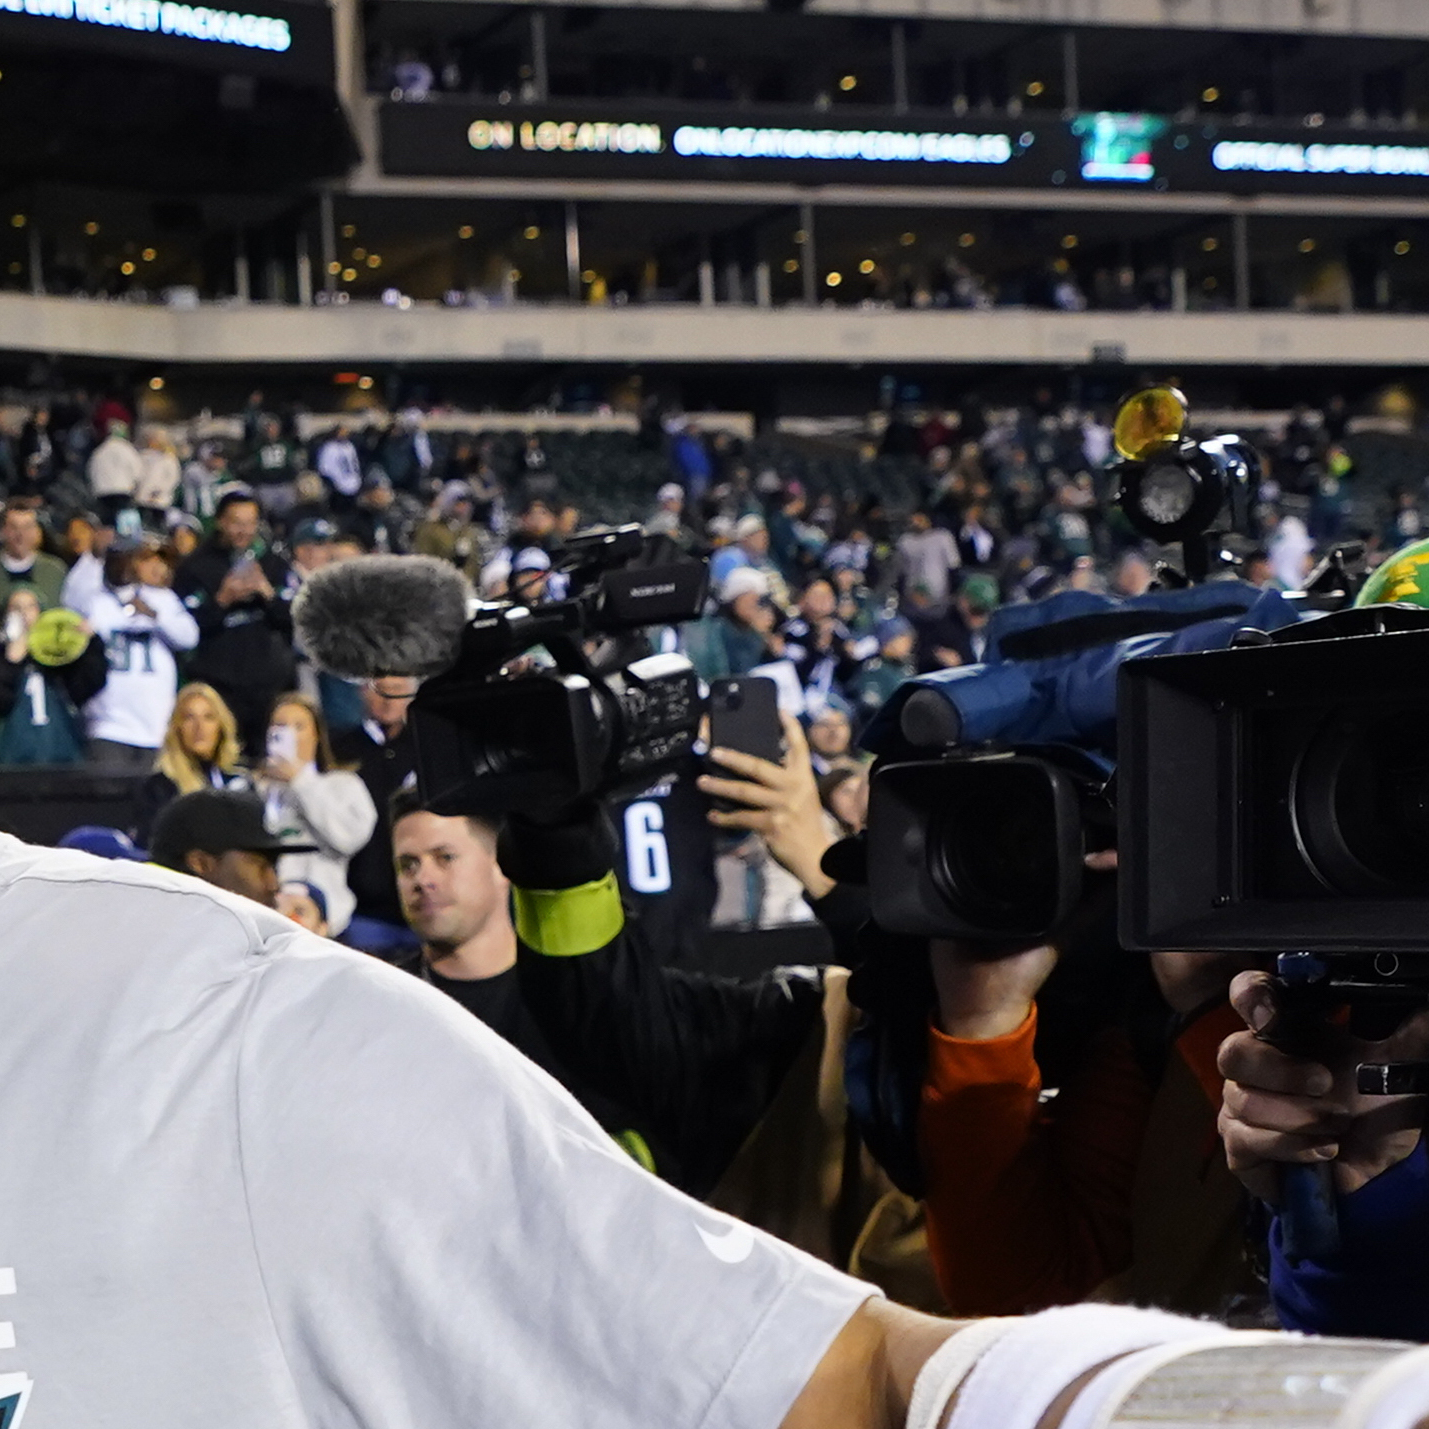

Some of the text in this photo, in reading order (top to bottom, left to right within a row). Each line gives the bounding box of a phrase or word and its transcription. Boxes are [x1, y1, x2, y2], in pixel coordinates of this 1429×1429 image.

[160, 1, 291, 52] PACKAGES
[467, 119, 513, 150] ON
[520, 120, 662, 154] LOCATION
[26, 671, 50, 726] 1
[624, 801, 672, 893] 6
